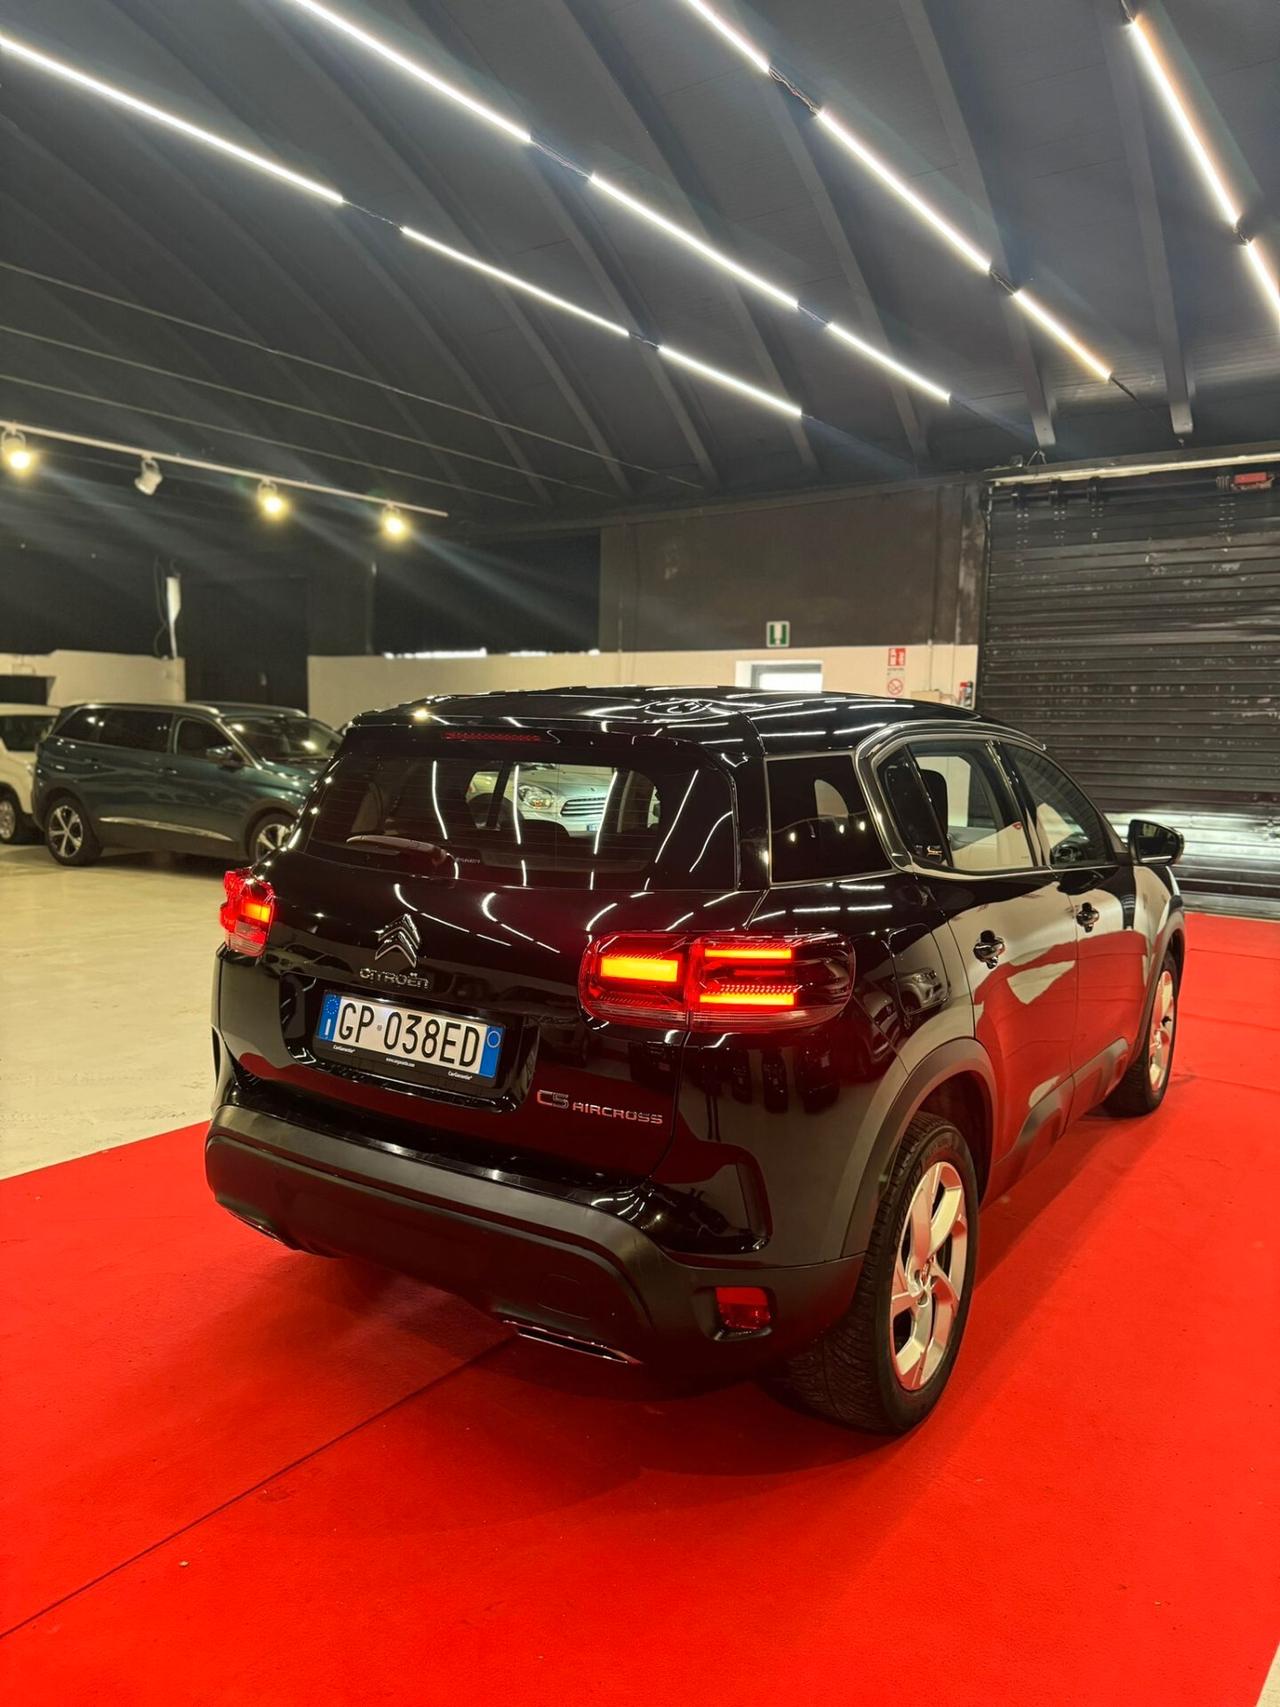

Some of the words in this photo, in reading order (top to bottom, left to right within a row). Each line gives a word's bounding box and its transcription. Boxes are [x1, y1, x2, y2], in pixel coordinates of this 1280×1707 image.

[338, 1002, 374, 1043] GP
[383, 1011, 480, 1067] 038ED
[536, 1089, 569, 1109] C5
[572, 1102, 663, 1124] AIRCROSS
